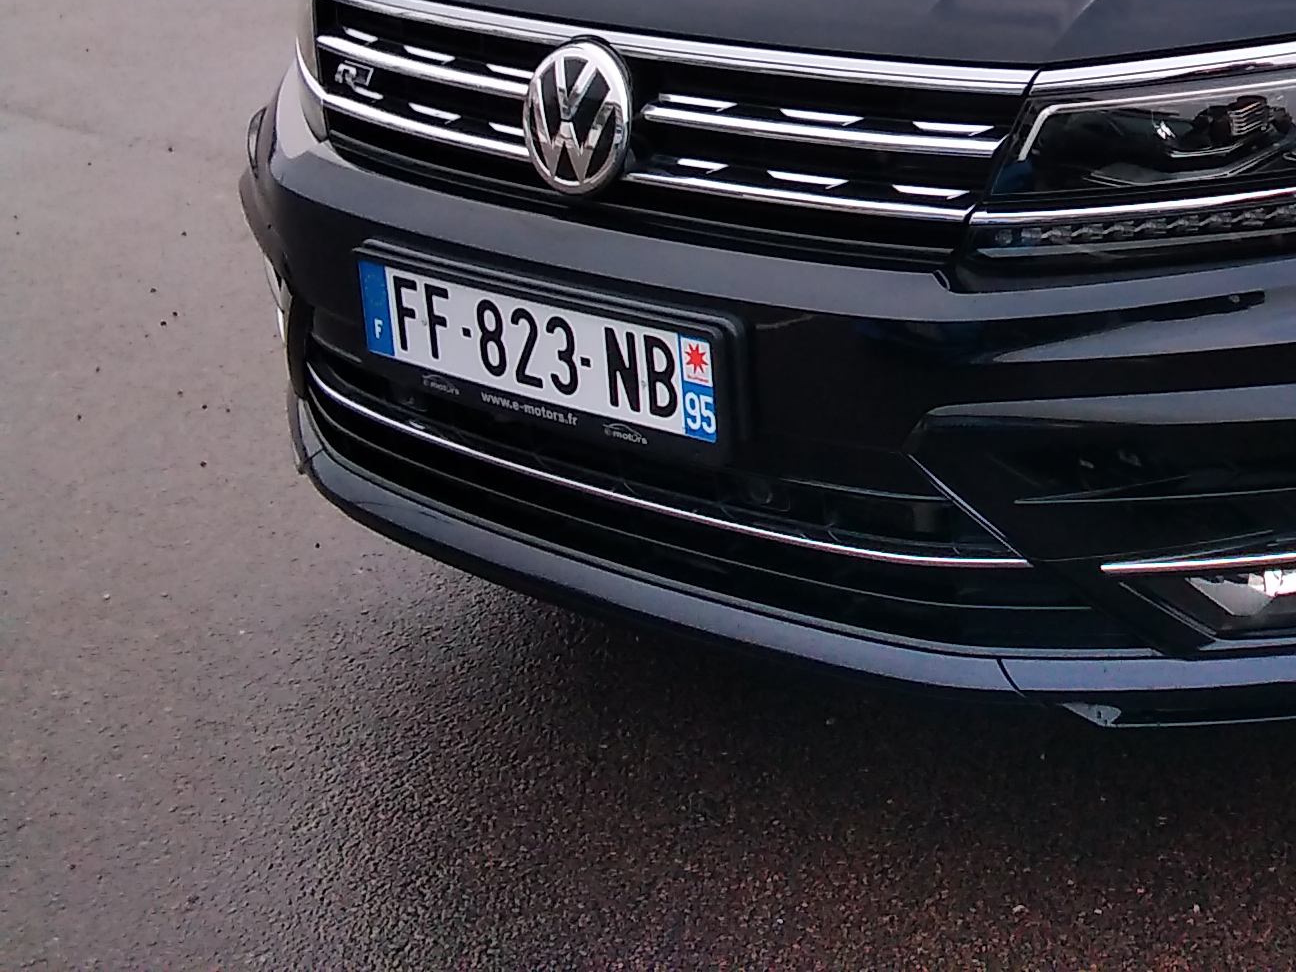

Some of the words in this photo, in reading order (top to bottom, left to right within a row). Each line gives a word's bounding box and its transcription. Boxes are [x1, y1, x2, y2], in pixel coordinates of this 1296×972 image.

[373, 317, 384, 339] F
[392, 274, 679, 419] FF-823-NB
[480, 390, 579, 426] www.e-motors.fr
[684, 391, 717, 434] 95
